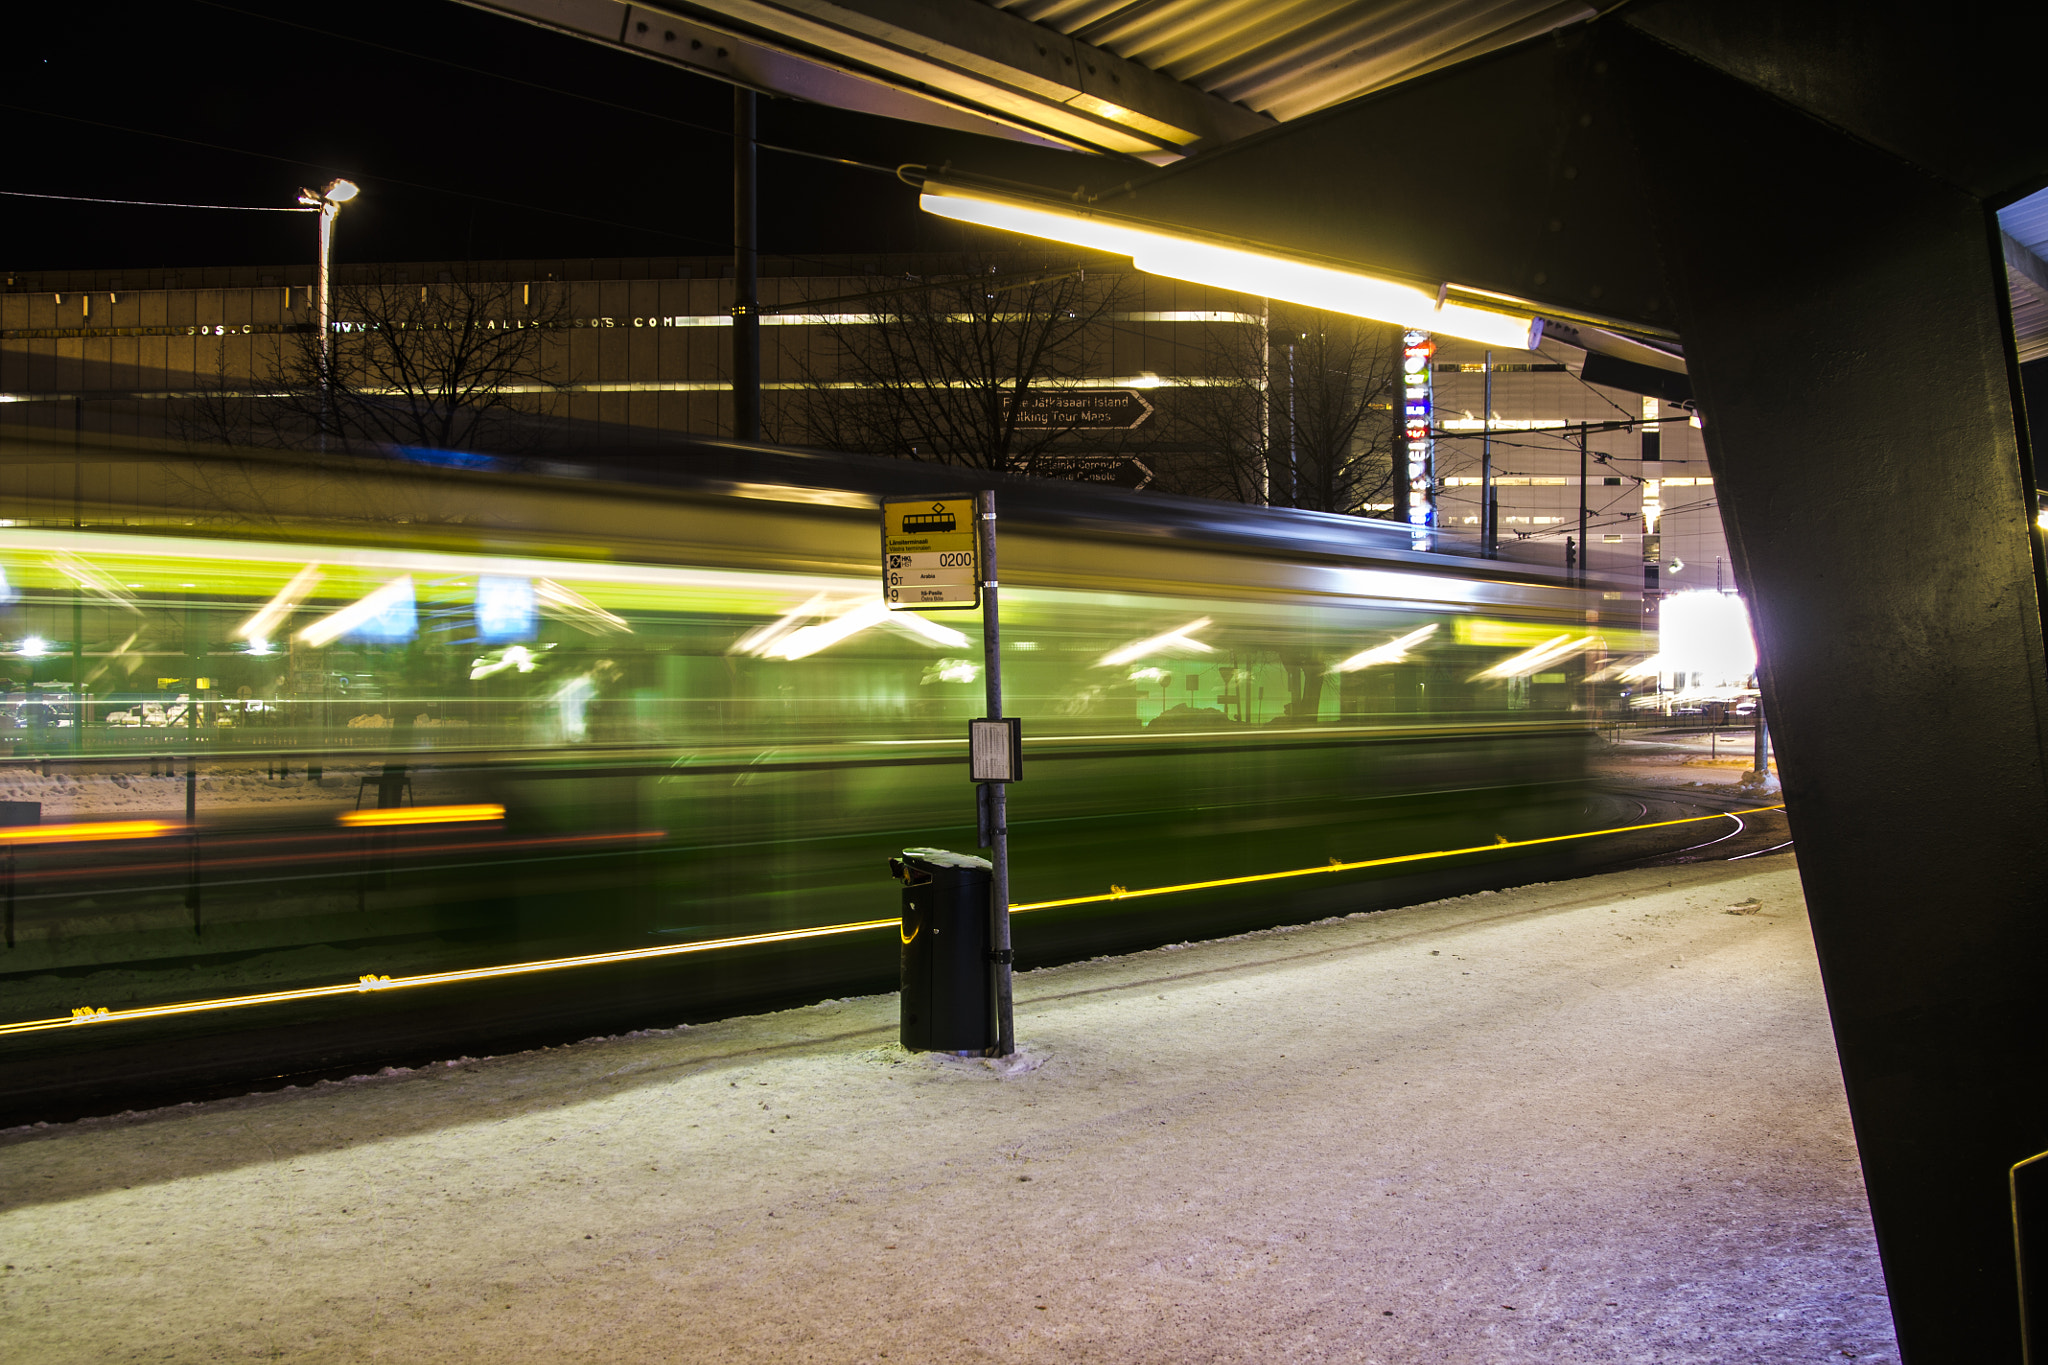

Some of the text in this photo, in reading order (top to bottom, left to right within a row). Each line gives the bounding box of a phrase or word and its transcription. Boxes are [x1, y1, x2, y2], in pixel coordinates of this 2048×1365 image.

[1003, 397, 1029, 408] Fe
[1094, 396, 1129, 408] Island
[1052, 410, 1079, 422] Tour
[1081, 411, 1112, 424] Maps
[1079, 460, 1125, 471] Compute
[939, 552, 972, 567] 0200
[891, 589, 899, 602] 9
